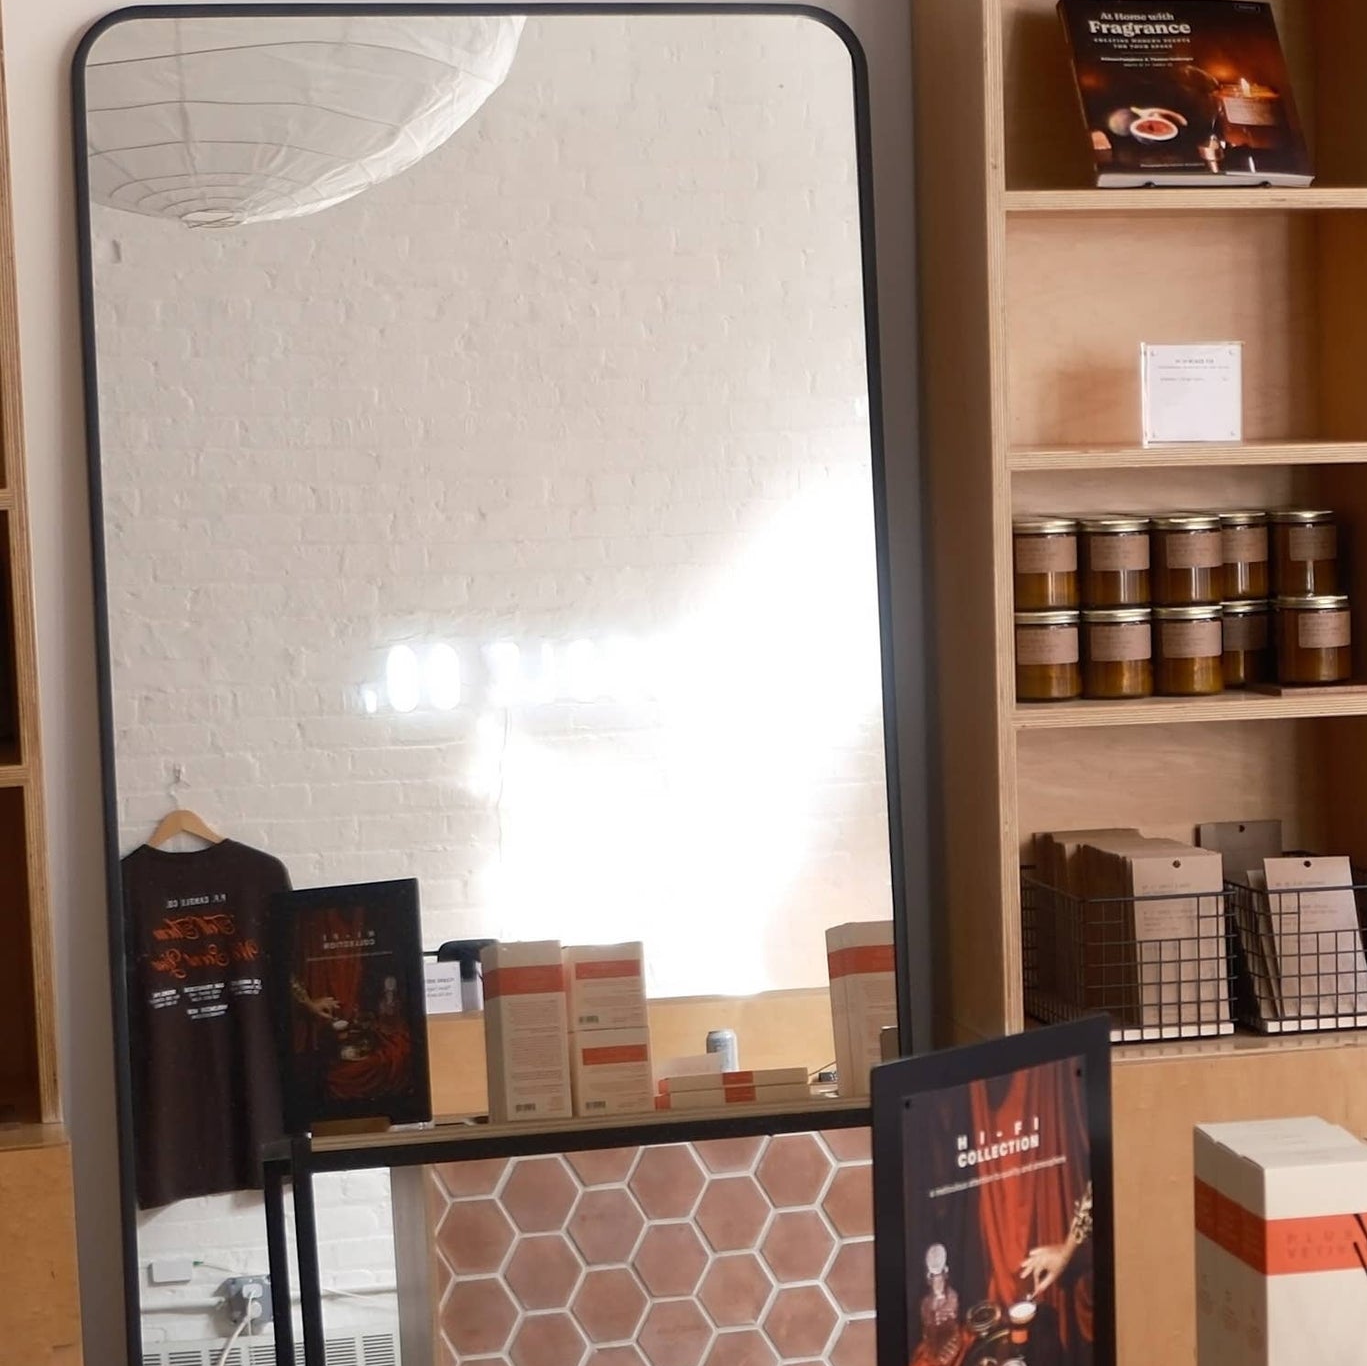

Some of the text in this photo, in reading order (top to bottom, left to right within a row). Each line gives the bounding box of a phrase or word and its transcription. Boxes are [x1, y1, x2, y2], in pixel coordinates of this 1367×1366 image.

[1100, 12, 1175, 21] At Home with
[1088, 20, 1191, 37] Fragrance
[957, 1133, 1039, 1168] COLLECTION
